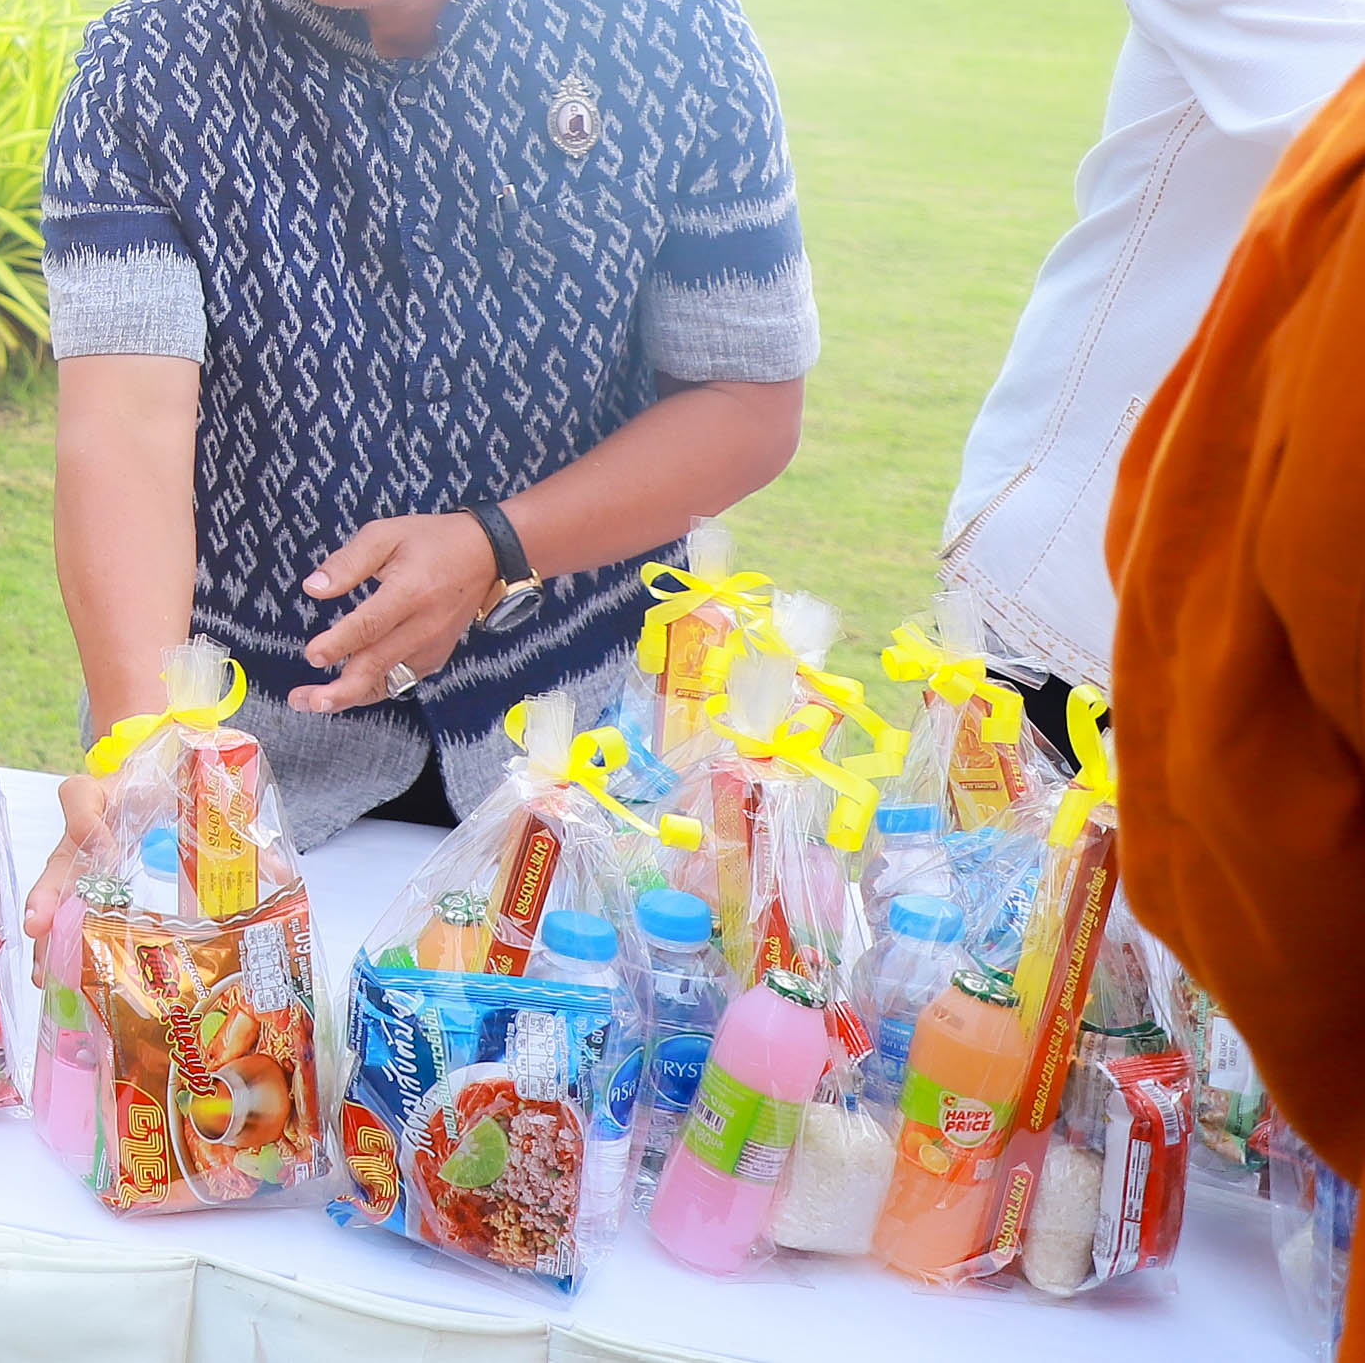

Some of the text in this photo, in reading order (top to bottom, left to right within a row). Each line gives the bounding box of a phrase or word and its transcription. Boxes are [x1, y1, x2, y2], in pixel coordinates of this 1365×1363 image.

[515, 840, 550, 916] มหามงคล
[945, 1108, 994, 1121] HAPPY
[944, 1120, 991, 1132] PRICE
